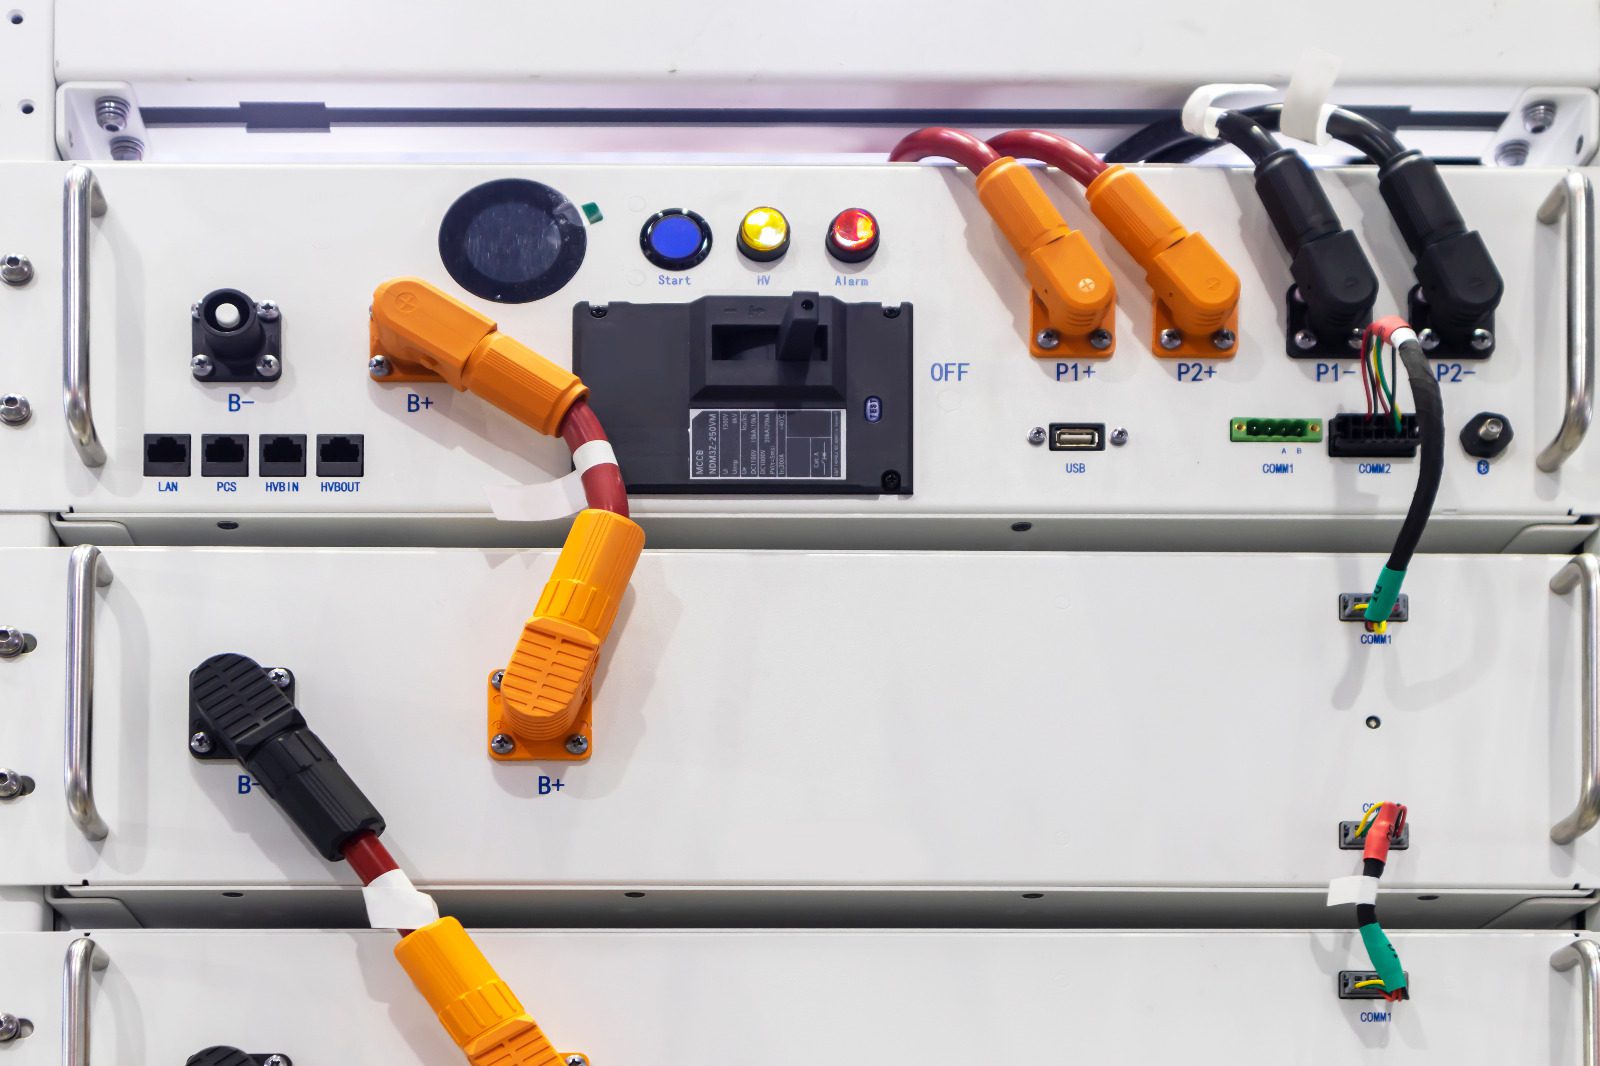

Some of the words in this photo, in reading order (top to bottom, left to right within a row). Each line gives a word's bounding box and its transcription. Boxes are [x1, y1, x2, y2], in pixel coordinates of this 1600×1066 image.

[658, 275, 692, 286] Start
[756, 275, 771, 286] HV
[835, 275, 869, 286] Alarm
[930, 362, 969, 382] OFF
[1056, 363, 1096, 382] P1+
[1177, 363, 1218, 382] P2+
[1316, 363, 1356, 382] P1-
[1436, 363, 1476, 382] P2-
[227, 393, 255, 413] B-
[407, 393, 434, 413] B+
[869, 399, 878, 419] TEST
[708, 413, 717, 475] NDM3Z-250VM
[1281, 447, 1288, 455] A
[1296, 447, 1303, 455] B
[695, 450, 704, 475] MCCB
[1065, 463, 1086, 474] USB
[1262, 463, 1294, 474] COMM1
[1358, 463, 1391, 474] COMM2
[158, 481, 179, 493] LAN
[216, 481, 238, 493] PCS
[265, 481, 299, 493] HVBIN
[320, 481, 361, 493] HVBOUT
[1360, 634, 1392, 645] COMM1
[537, 775, 564, 795] B+
[1360, 1012, 1392, 1023] COMM1
